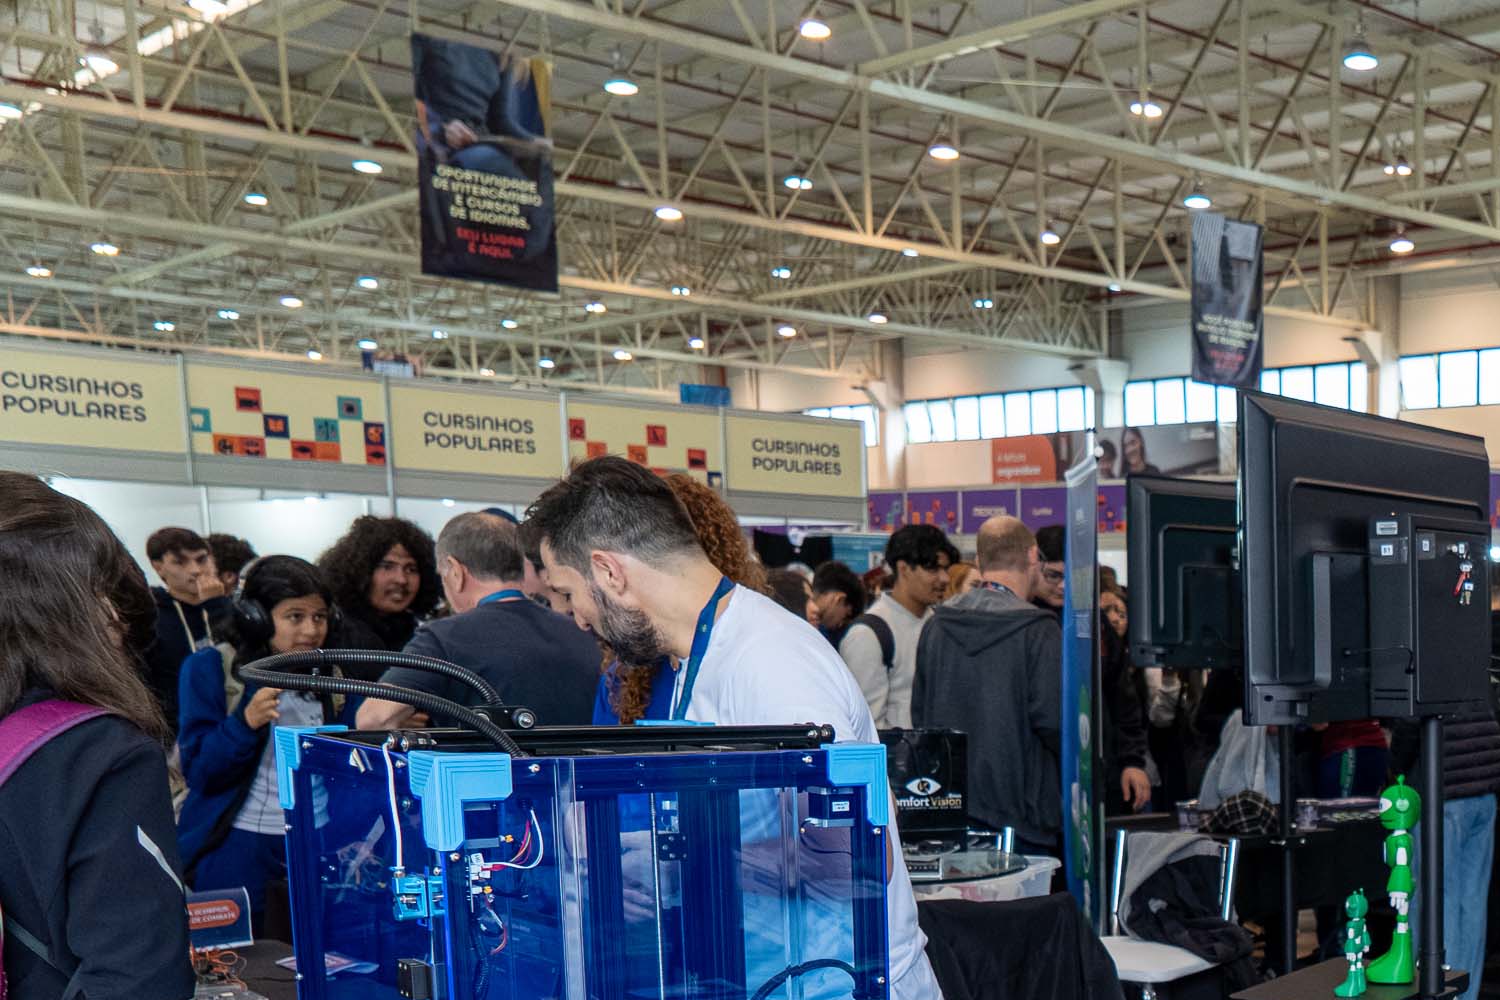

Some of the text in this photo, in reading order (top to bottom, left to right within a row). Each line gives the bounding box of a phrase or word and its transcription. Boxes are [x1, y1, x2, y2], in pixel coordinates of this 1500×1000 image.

[1, 371, 144, 400] CURSINHOS
[3, 395, 147, 422] POPULARES
[423, 411, 535, 434] CURSINHOS
[424, 432, 537, 454] POPULARES
[752, 438, 841, 458] CURSINHOS
[752, 457, 842, 476] POPULARES
[930, 796, 961, 807] Vision
